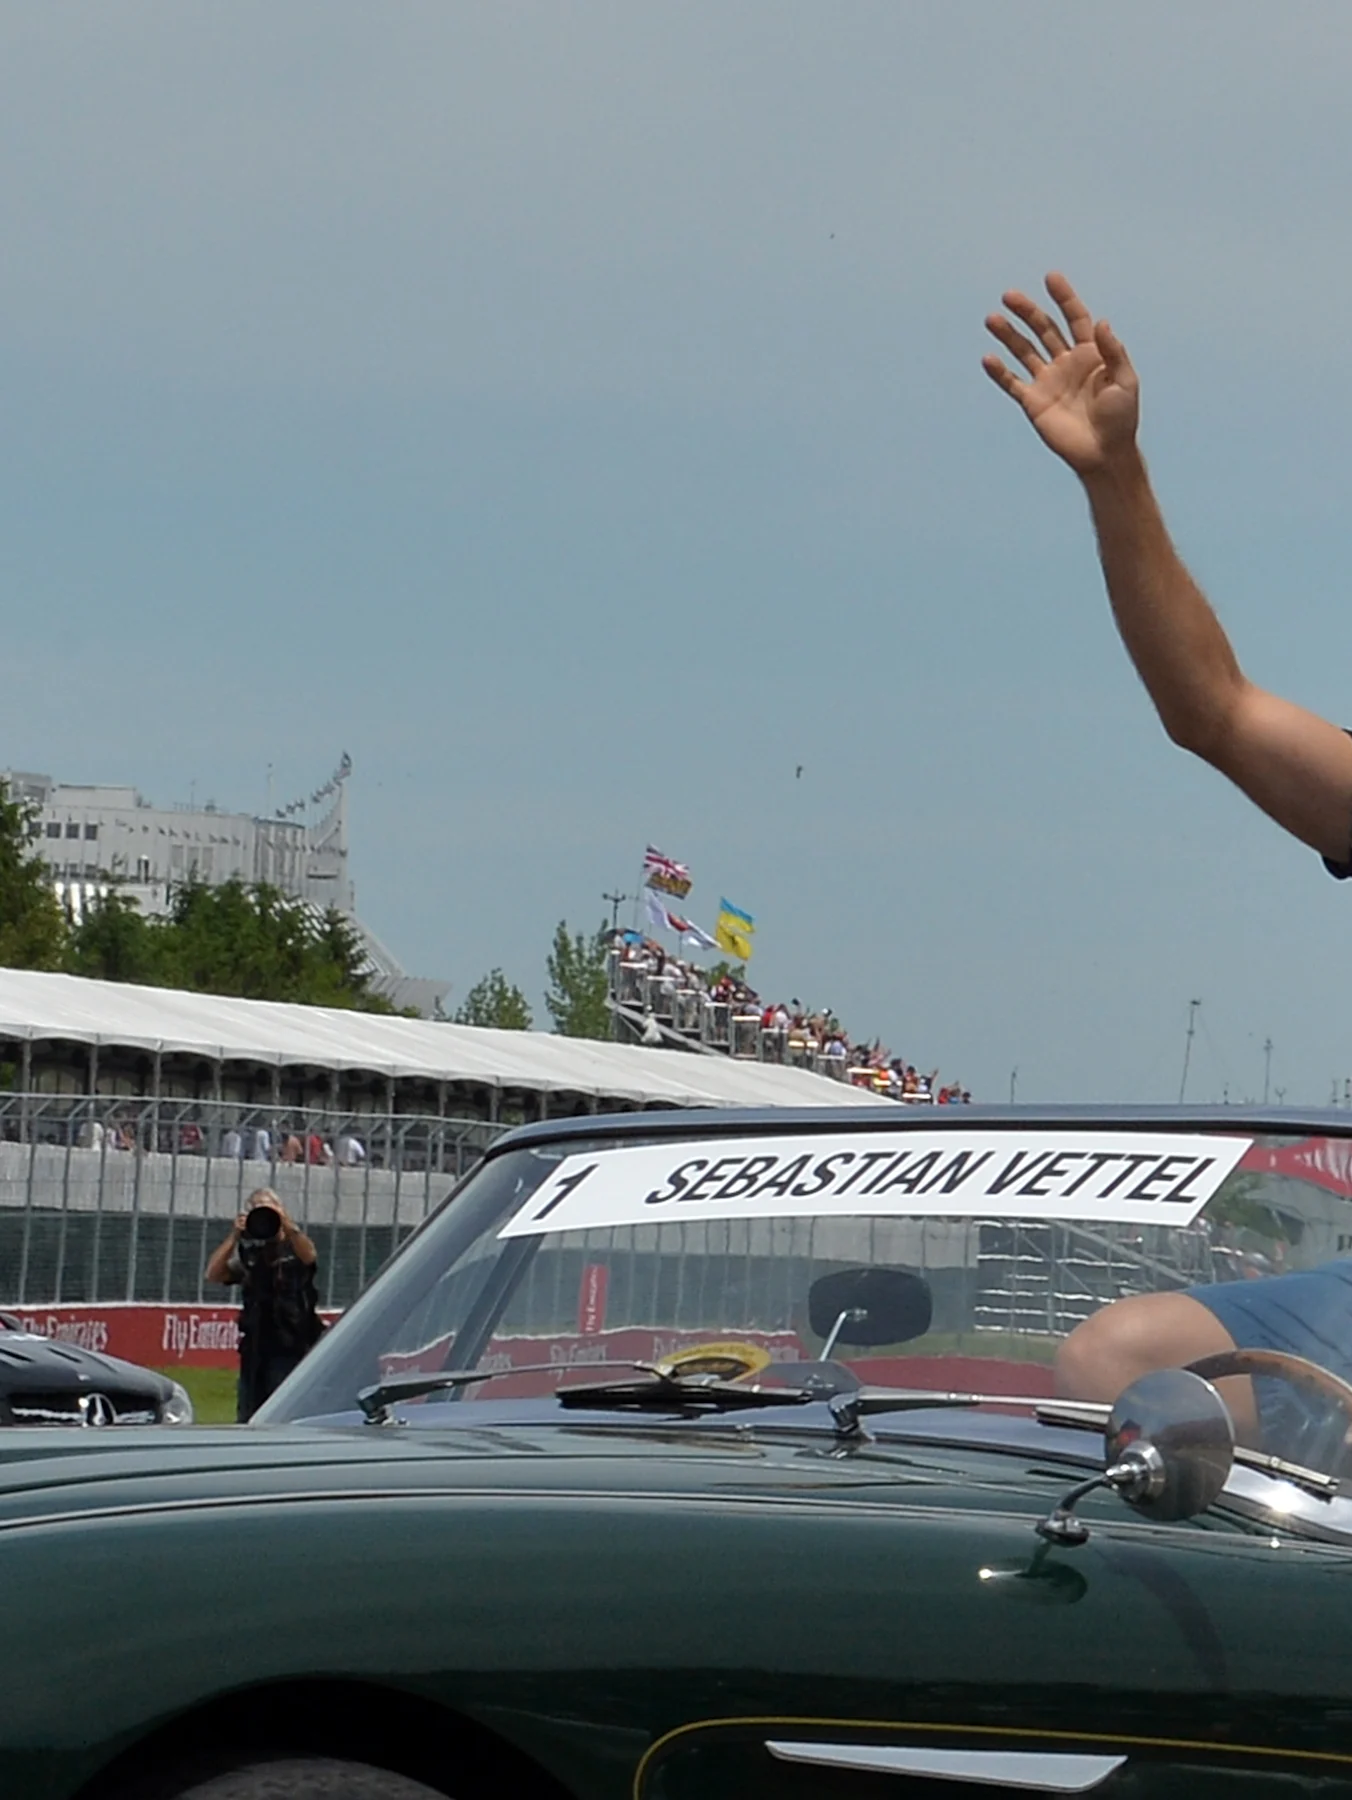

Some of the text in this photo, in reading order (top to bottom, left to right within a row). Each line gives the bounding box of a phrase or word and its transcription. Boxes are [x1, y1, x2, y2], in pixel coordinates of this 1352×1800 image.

[532, 1163, 600, 1221] 1
[644, 1150, 1218, 1205] SEBASTIAN VETTEL
[46, 1313, 107, 1351] Emirates
[162, 1312, 243, 1359] Fly Emirate
